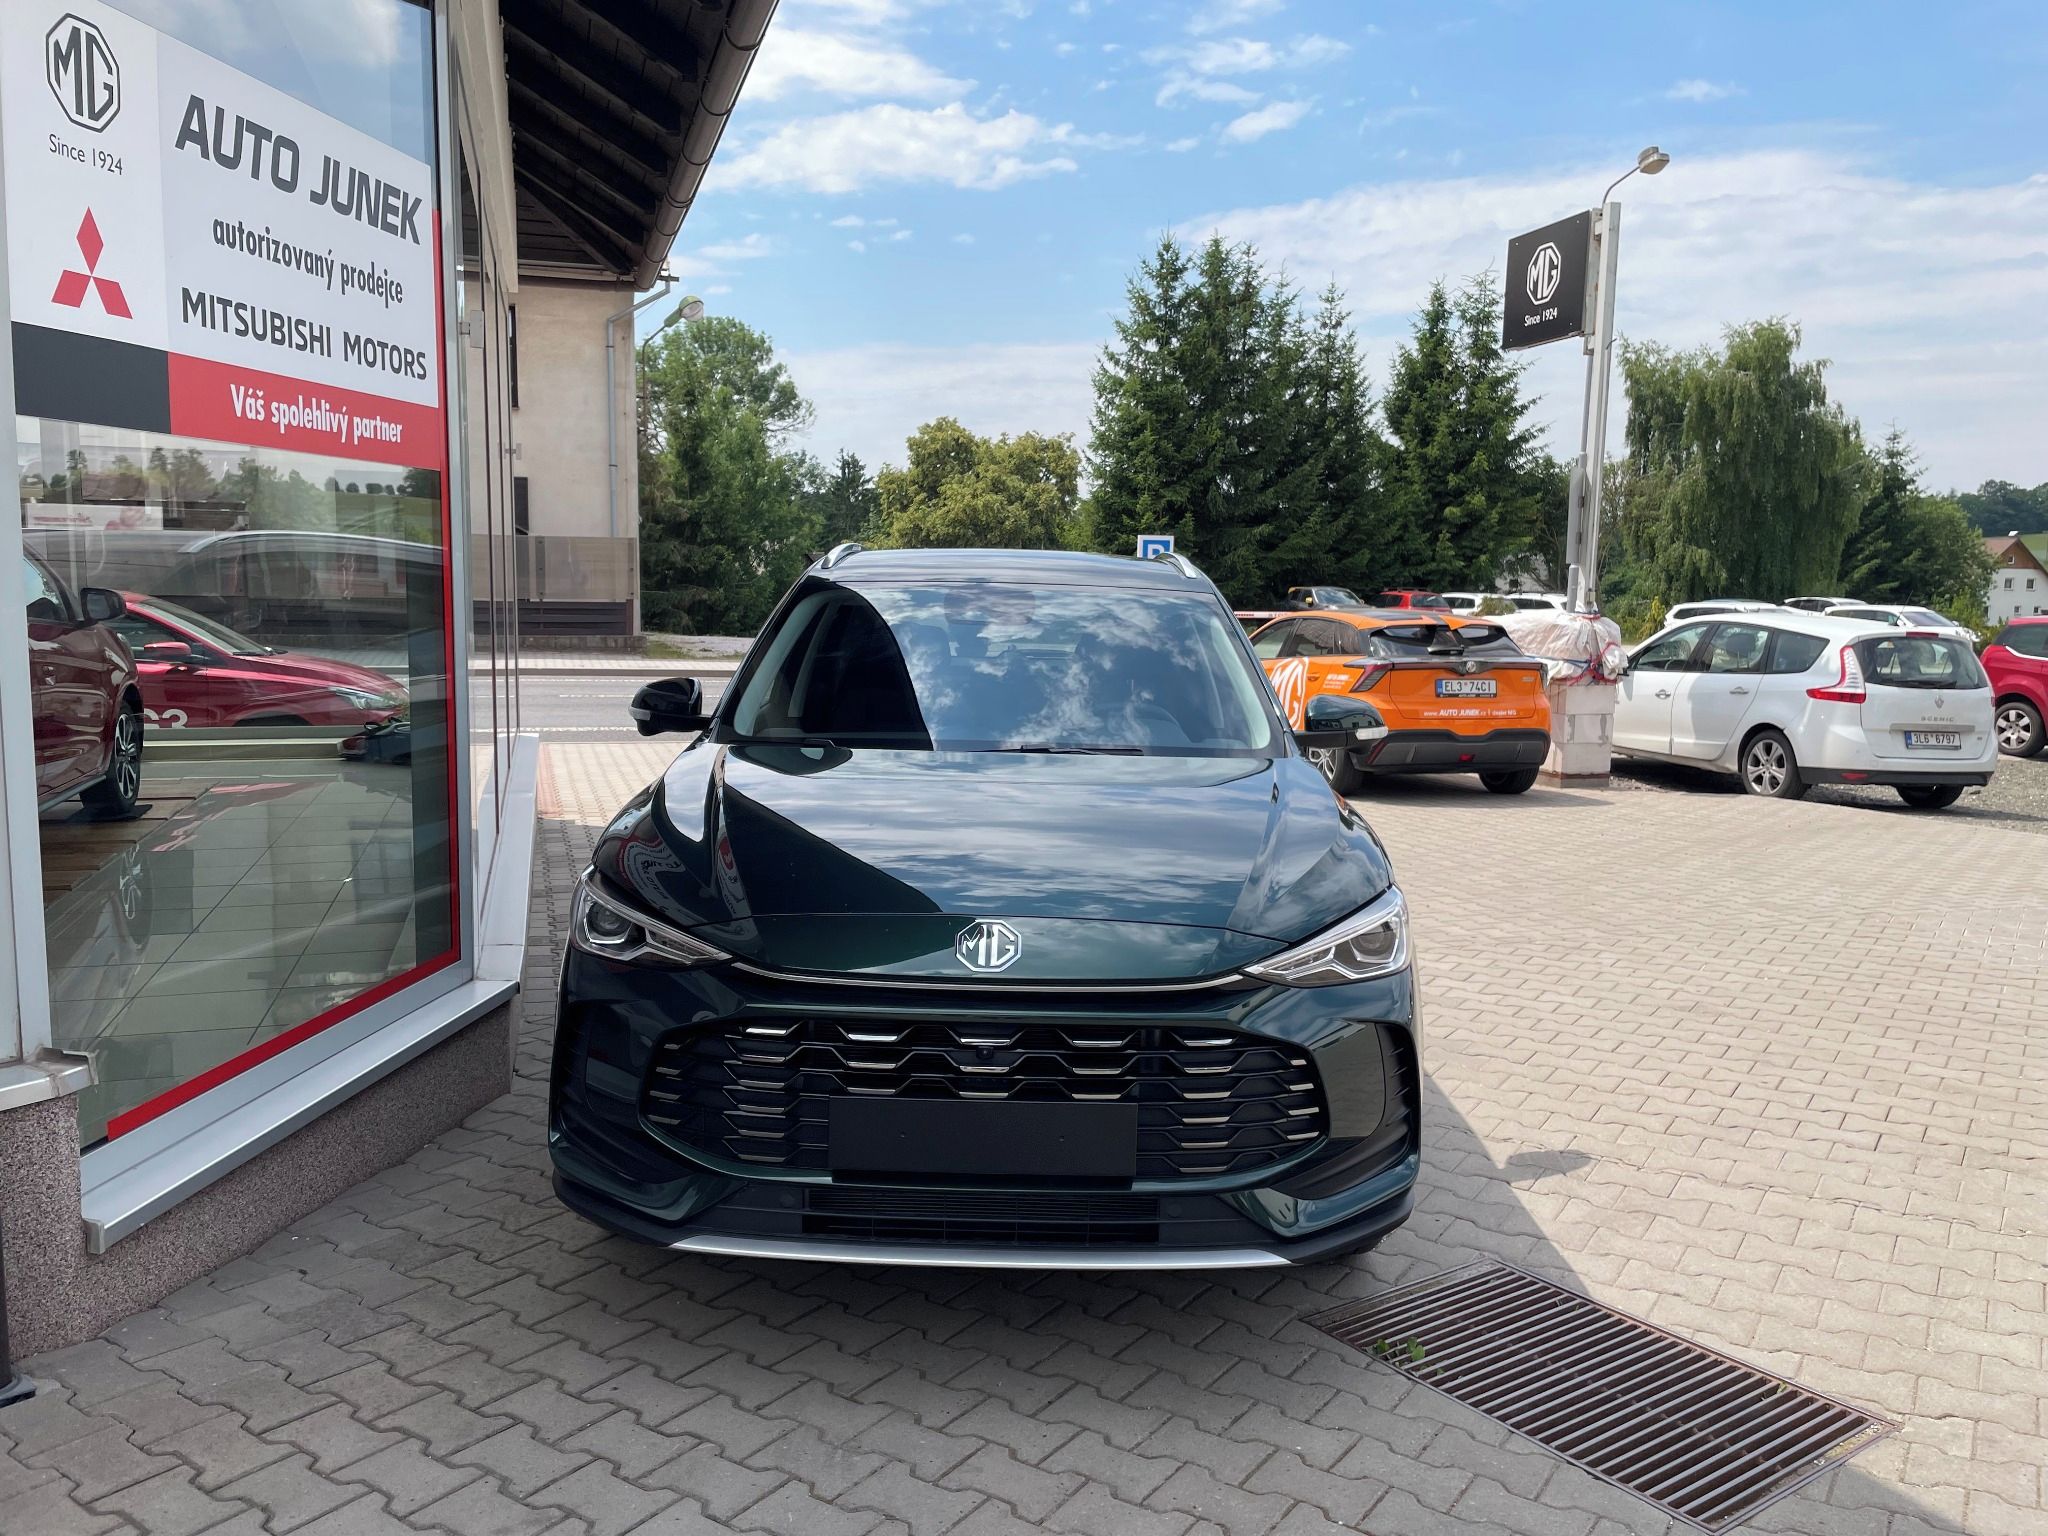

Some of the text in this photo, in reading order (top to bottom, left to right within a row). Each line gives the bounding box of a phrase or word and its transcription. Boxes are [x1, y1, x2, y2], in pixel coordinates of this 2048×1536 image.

[54, 26, 113, 122] MG
[49, 133, 123, 176] Since 1924
[175, 94, 423, 246] AUTO JUNEK
[213, 218, 403, 309] autorizovaný prodejce
[1529, 247, 1558, 300] MG
[181, 287, 427, 381] MITSUBISHI MOTORS
[1524, 307, 1558, 327] Since 1924
[230, 383, 403, 446] Váš spolehlivý partner
[1444, 681, 1463, 692] EL3
[1913, 733, 1930, 744] 3L6
[962, 924, 1015, 967] MG
